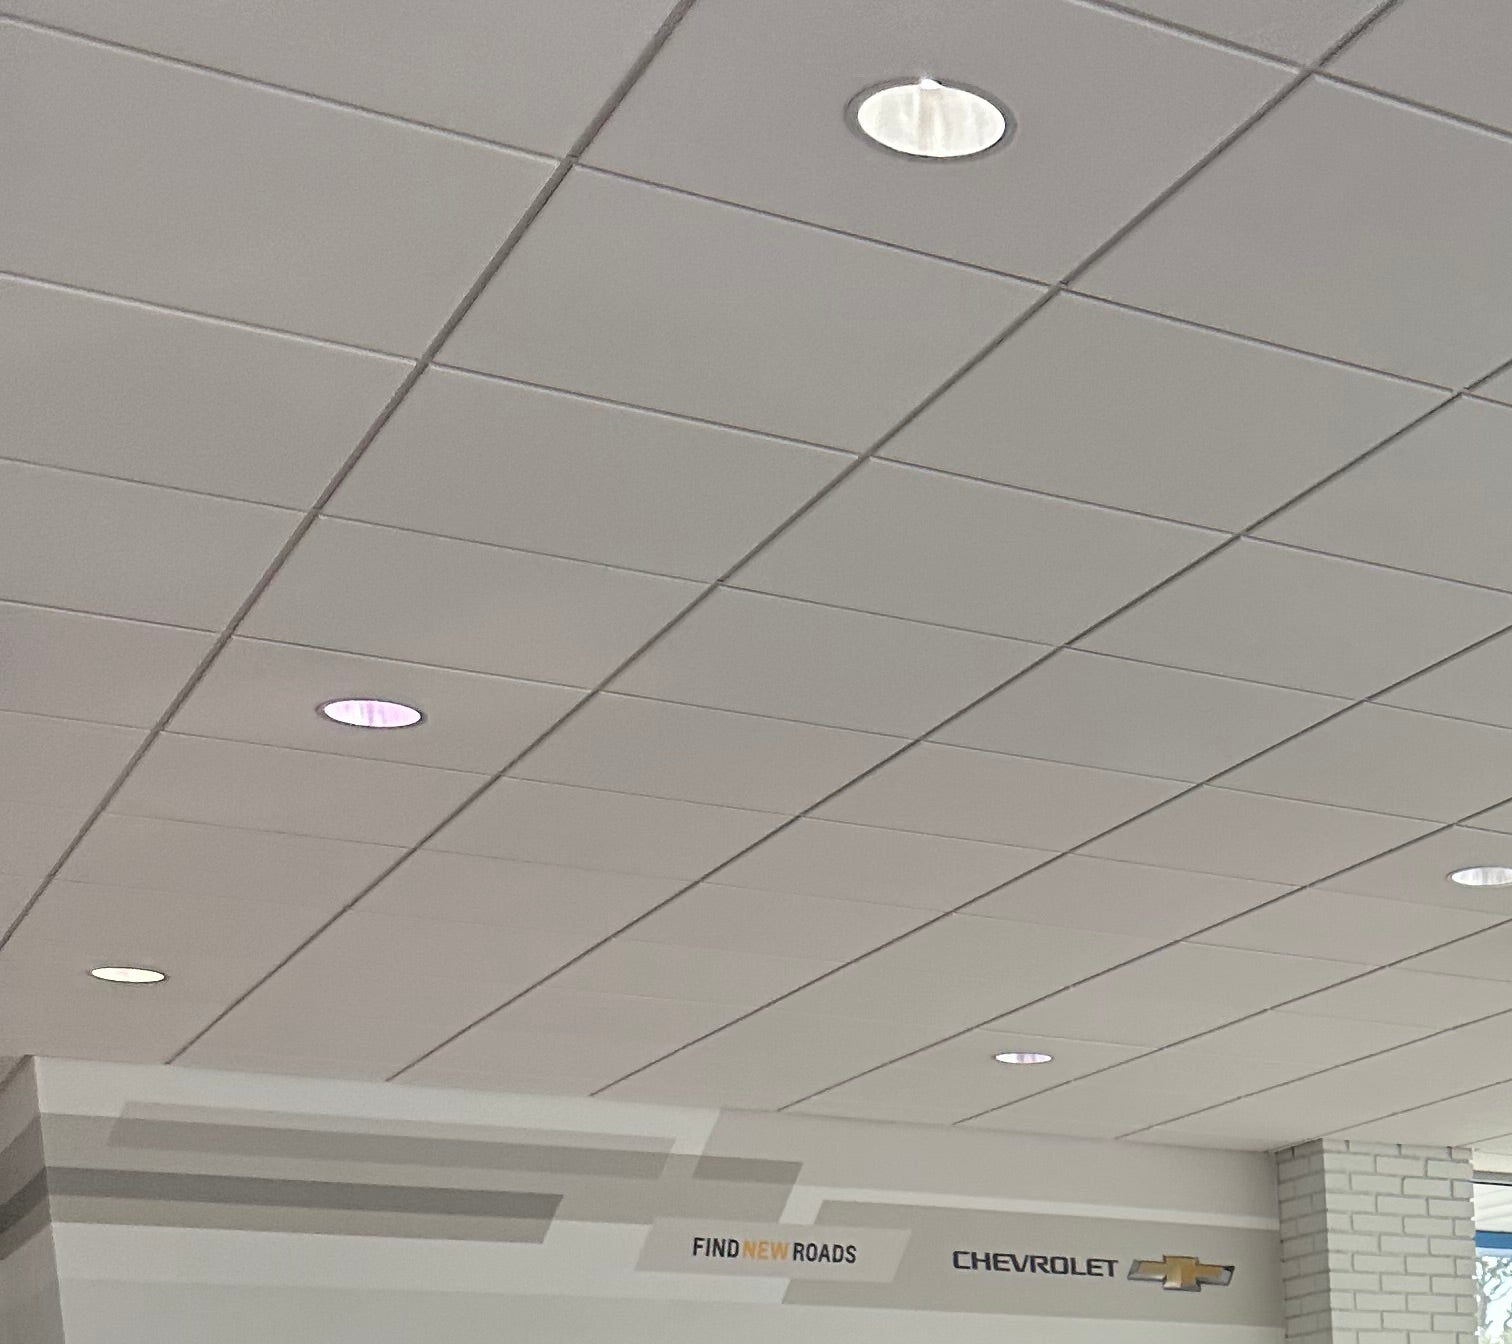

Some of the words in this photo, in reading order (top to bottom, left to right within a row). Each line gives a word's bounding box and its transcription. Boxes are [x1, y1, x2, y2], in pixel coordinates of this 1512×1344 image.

[692, 1236, 739, 1259] FIND
[742, 1238, 789, 1261] NEW
[792, 1241, 857, 1265] ROADS
[952, 1250, 1119, 1278] CHEVROLET
